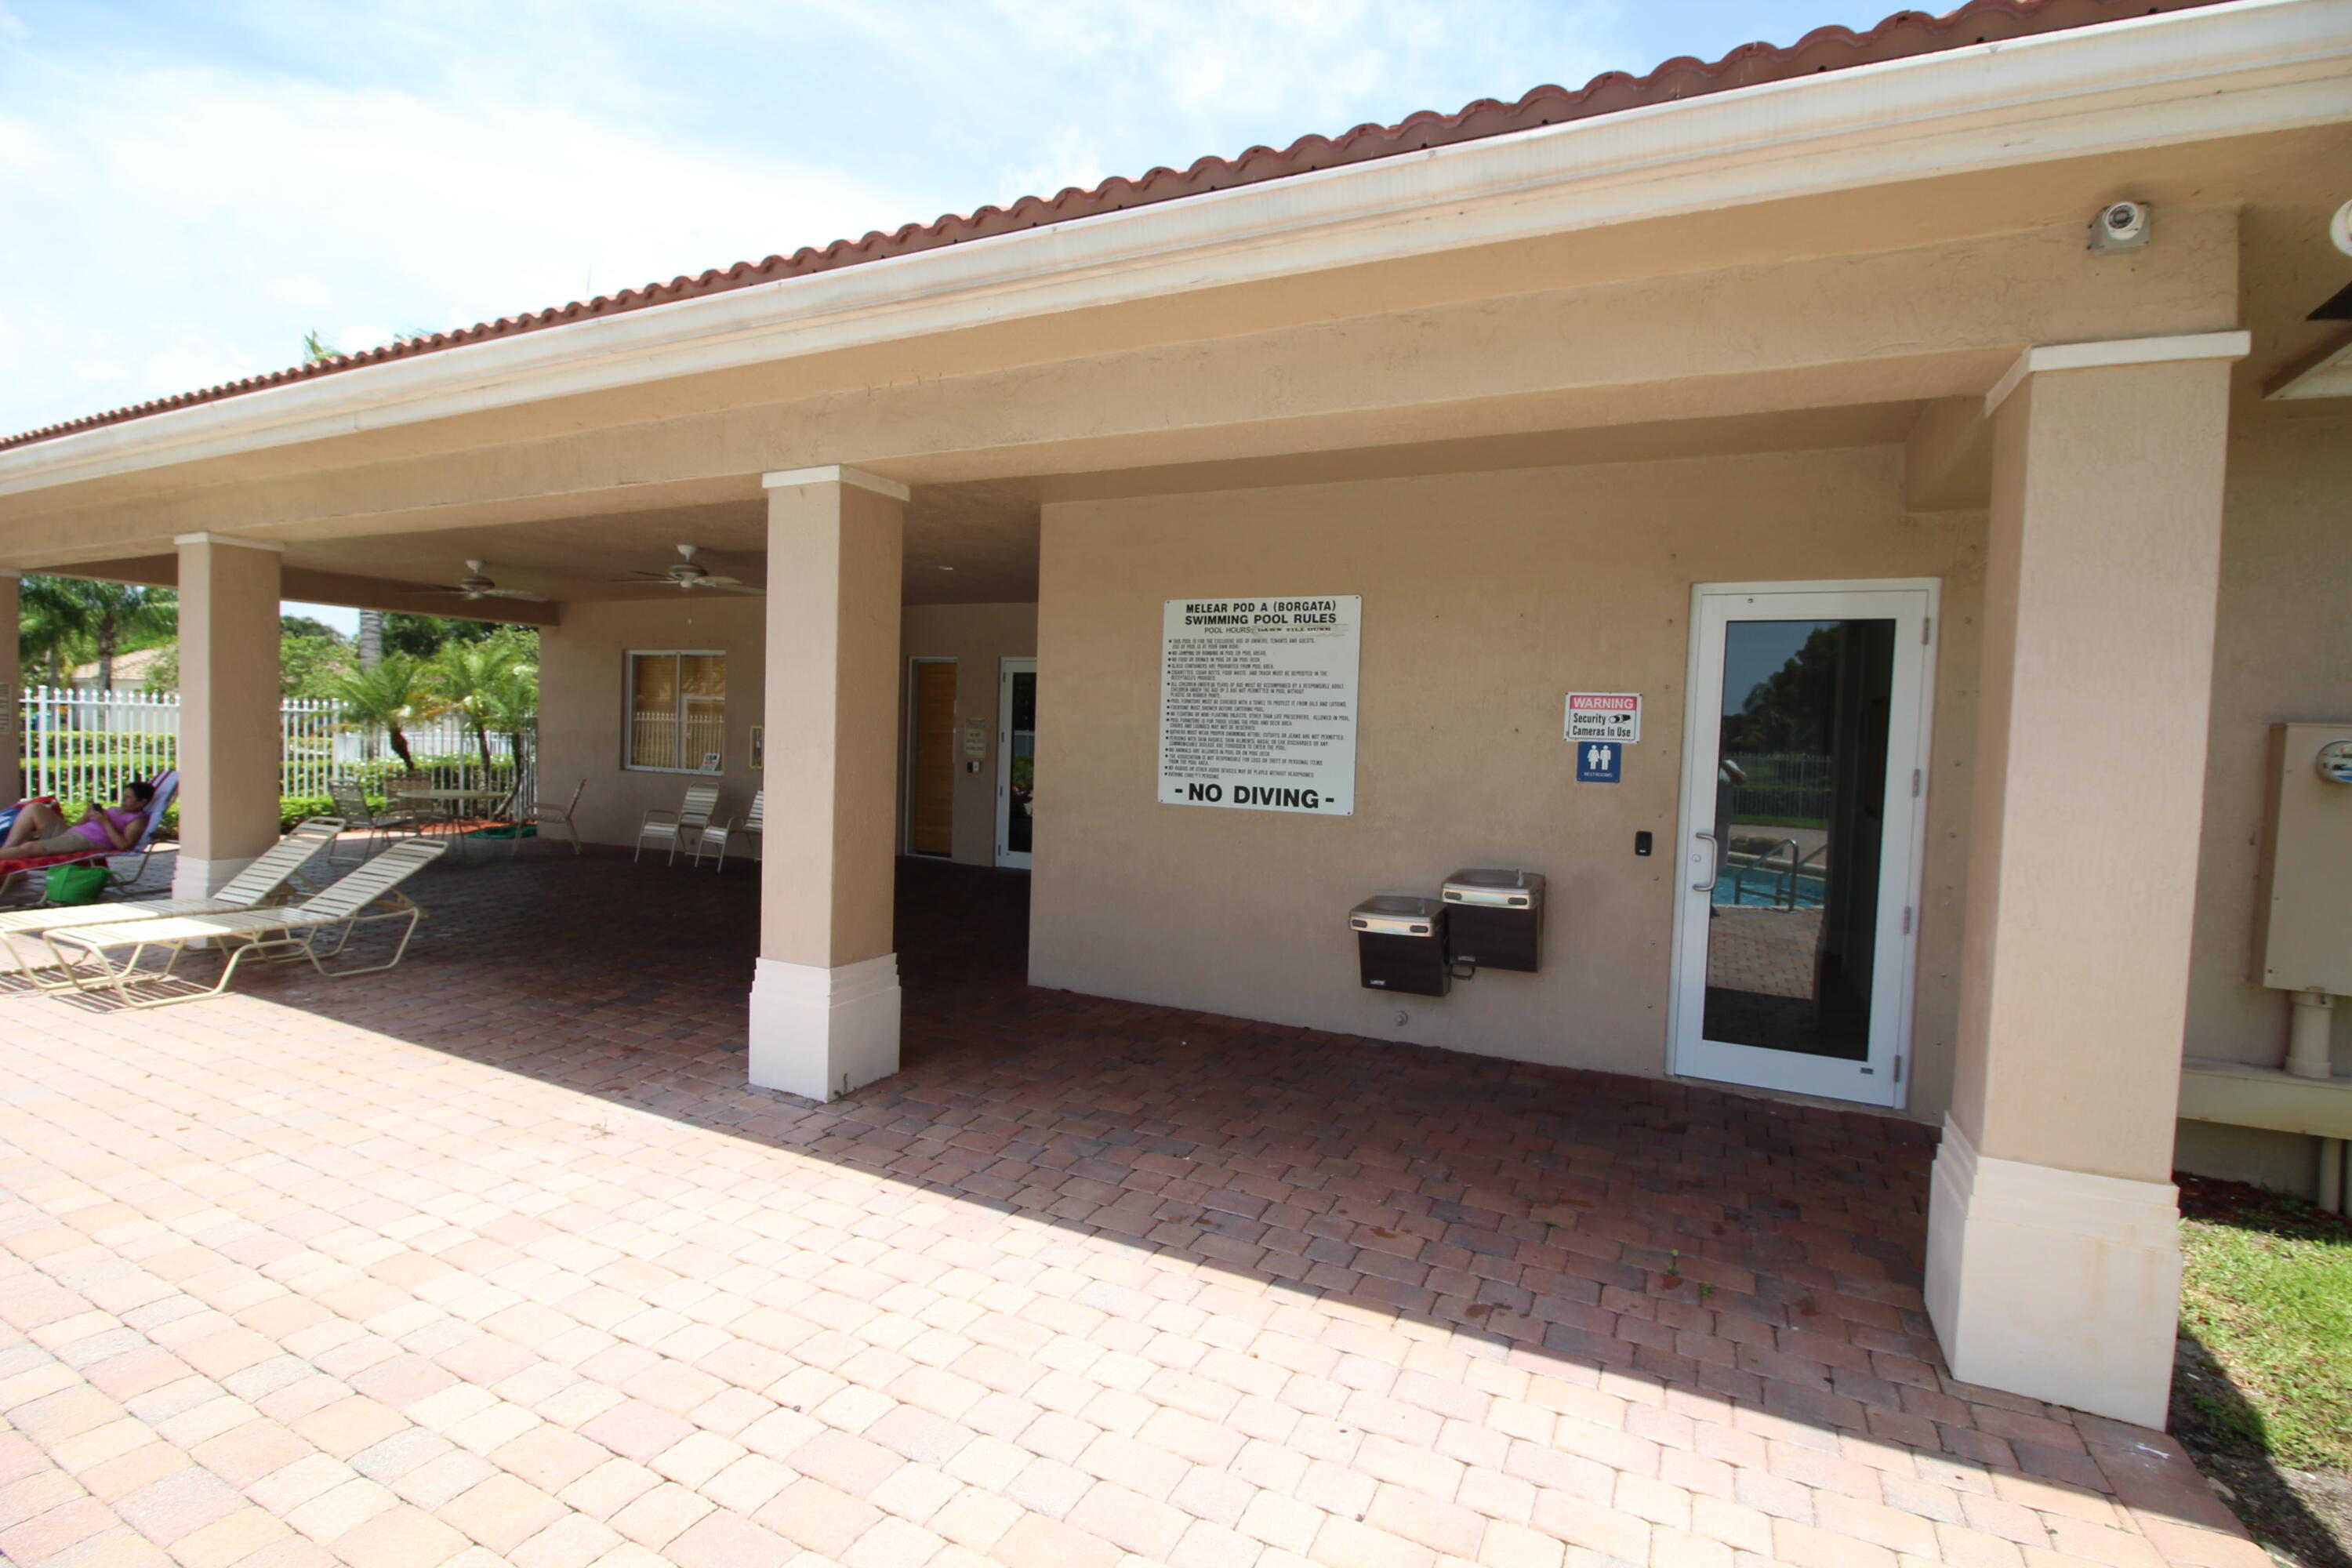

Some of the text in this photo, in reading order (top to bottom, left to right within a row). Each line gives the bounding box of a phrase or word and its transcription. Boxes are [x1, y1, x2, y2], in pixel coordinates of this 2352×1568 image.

[1186, 601, 1335, 613] MELEAR POD A (BORGATA)
[1185, 614, 1336, 625] SWIMMING POOL RULES
[1573, 698, 1632, 709] WARNING
[1573, 713, 1606, 725] Security
[1573, 724, 1631, 737] Cameras In Use
[1189, 783, 1221, 802] NO
[1234, 786, 1318, 808] DIVING
